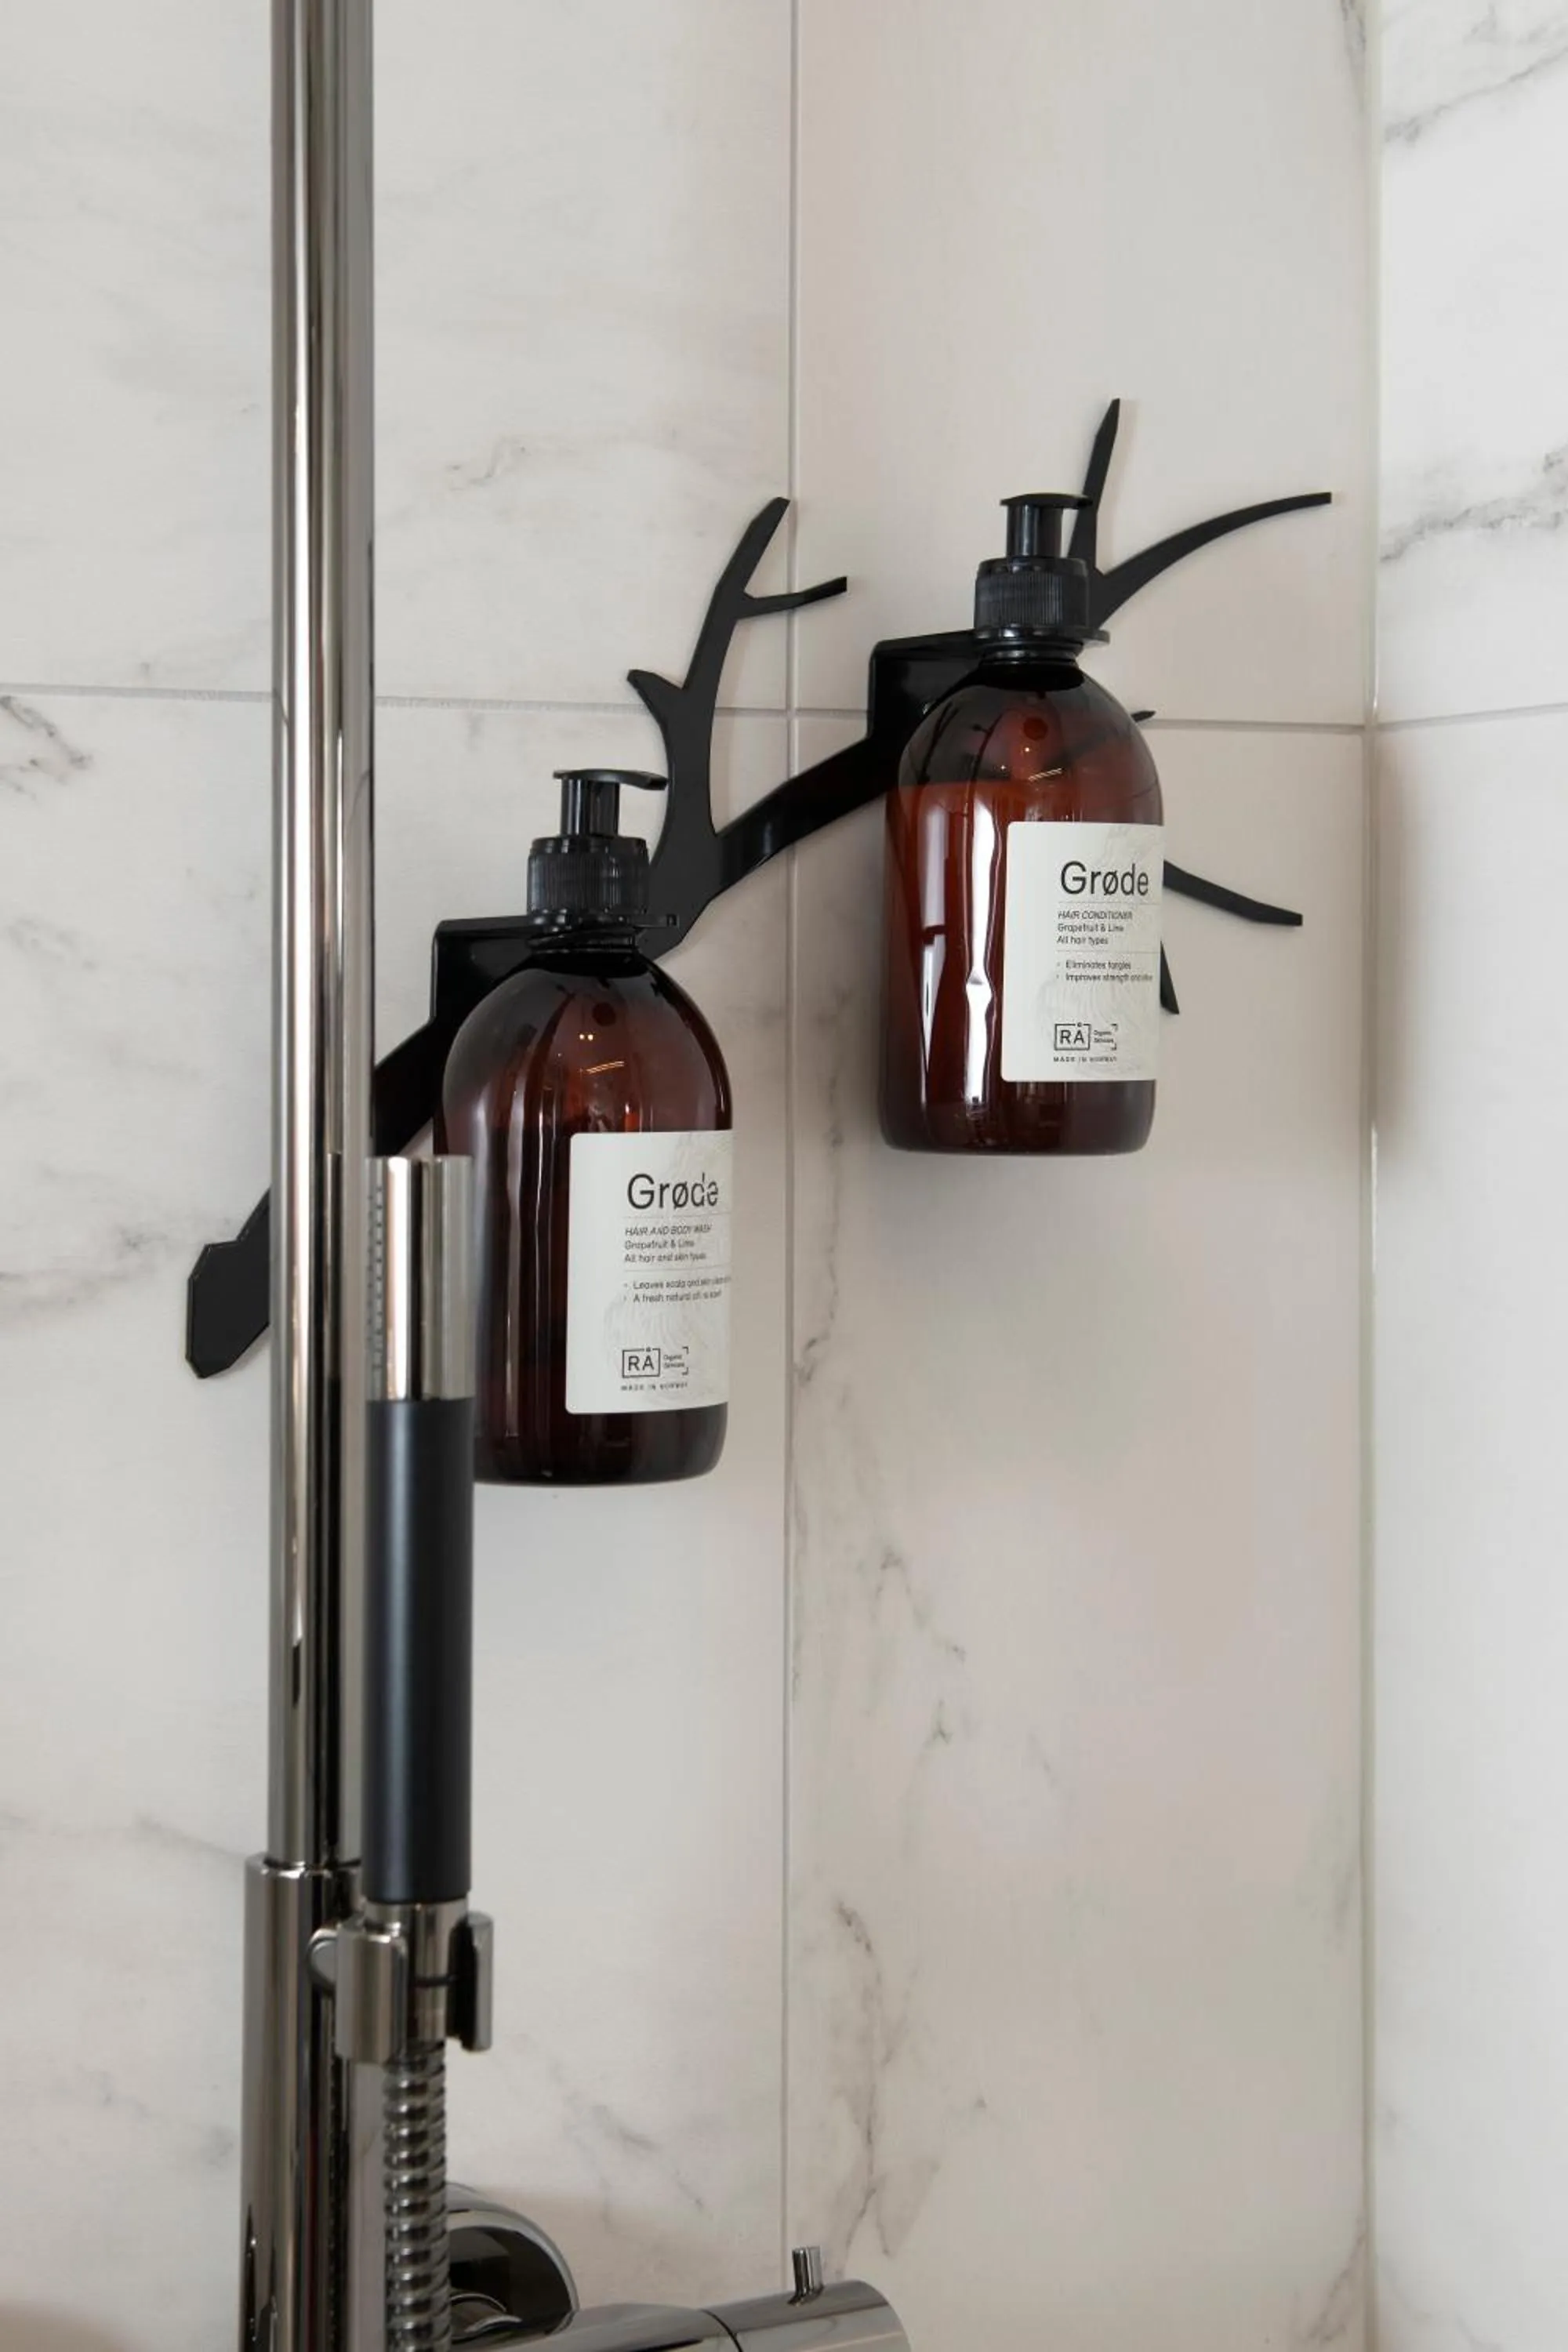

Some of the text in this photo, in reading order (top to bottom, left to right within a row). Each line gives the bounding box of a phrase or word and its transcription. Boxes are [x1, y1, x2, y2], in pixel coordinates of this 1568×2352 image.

[1061, 861, 1149, 896] Grøde
[1058, 910, 1080, 920] HAIR
[1057, 936, 1069, 945] All
[1070, 936, 1087, 945] hair
[1059, 1022, 1085, 1044] RÅ
[627, 1172, 719, 1210] Grøde
[625, 1226, 649, 1236] HAIR
[650, 1225, 670, 1236] AND
[670, 1225, 691, 1235] BODY
[627, 1347, 655, 1371] RÅ
